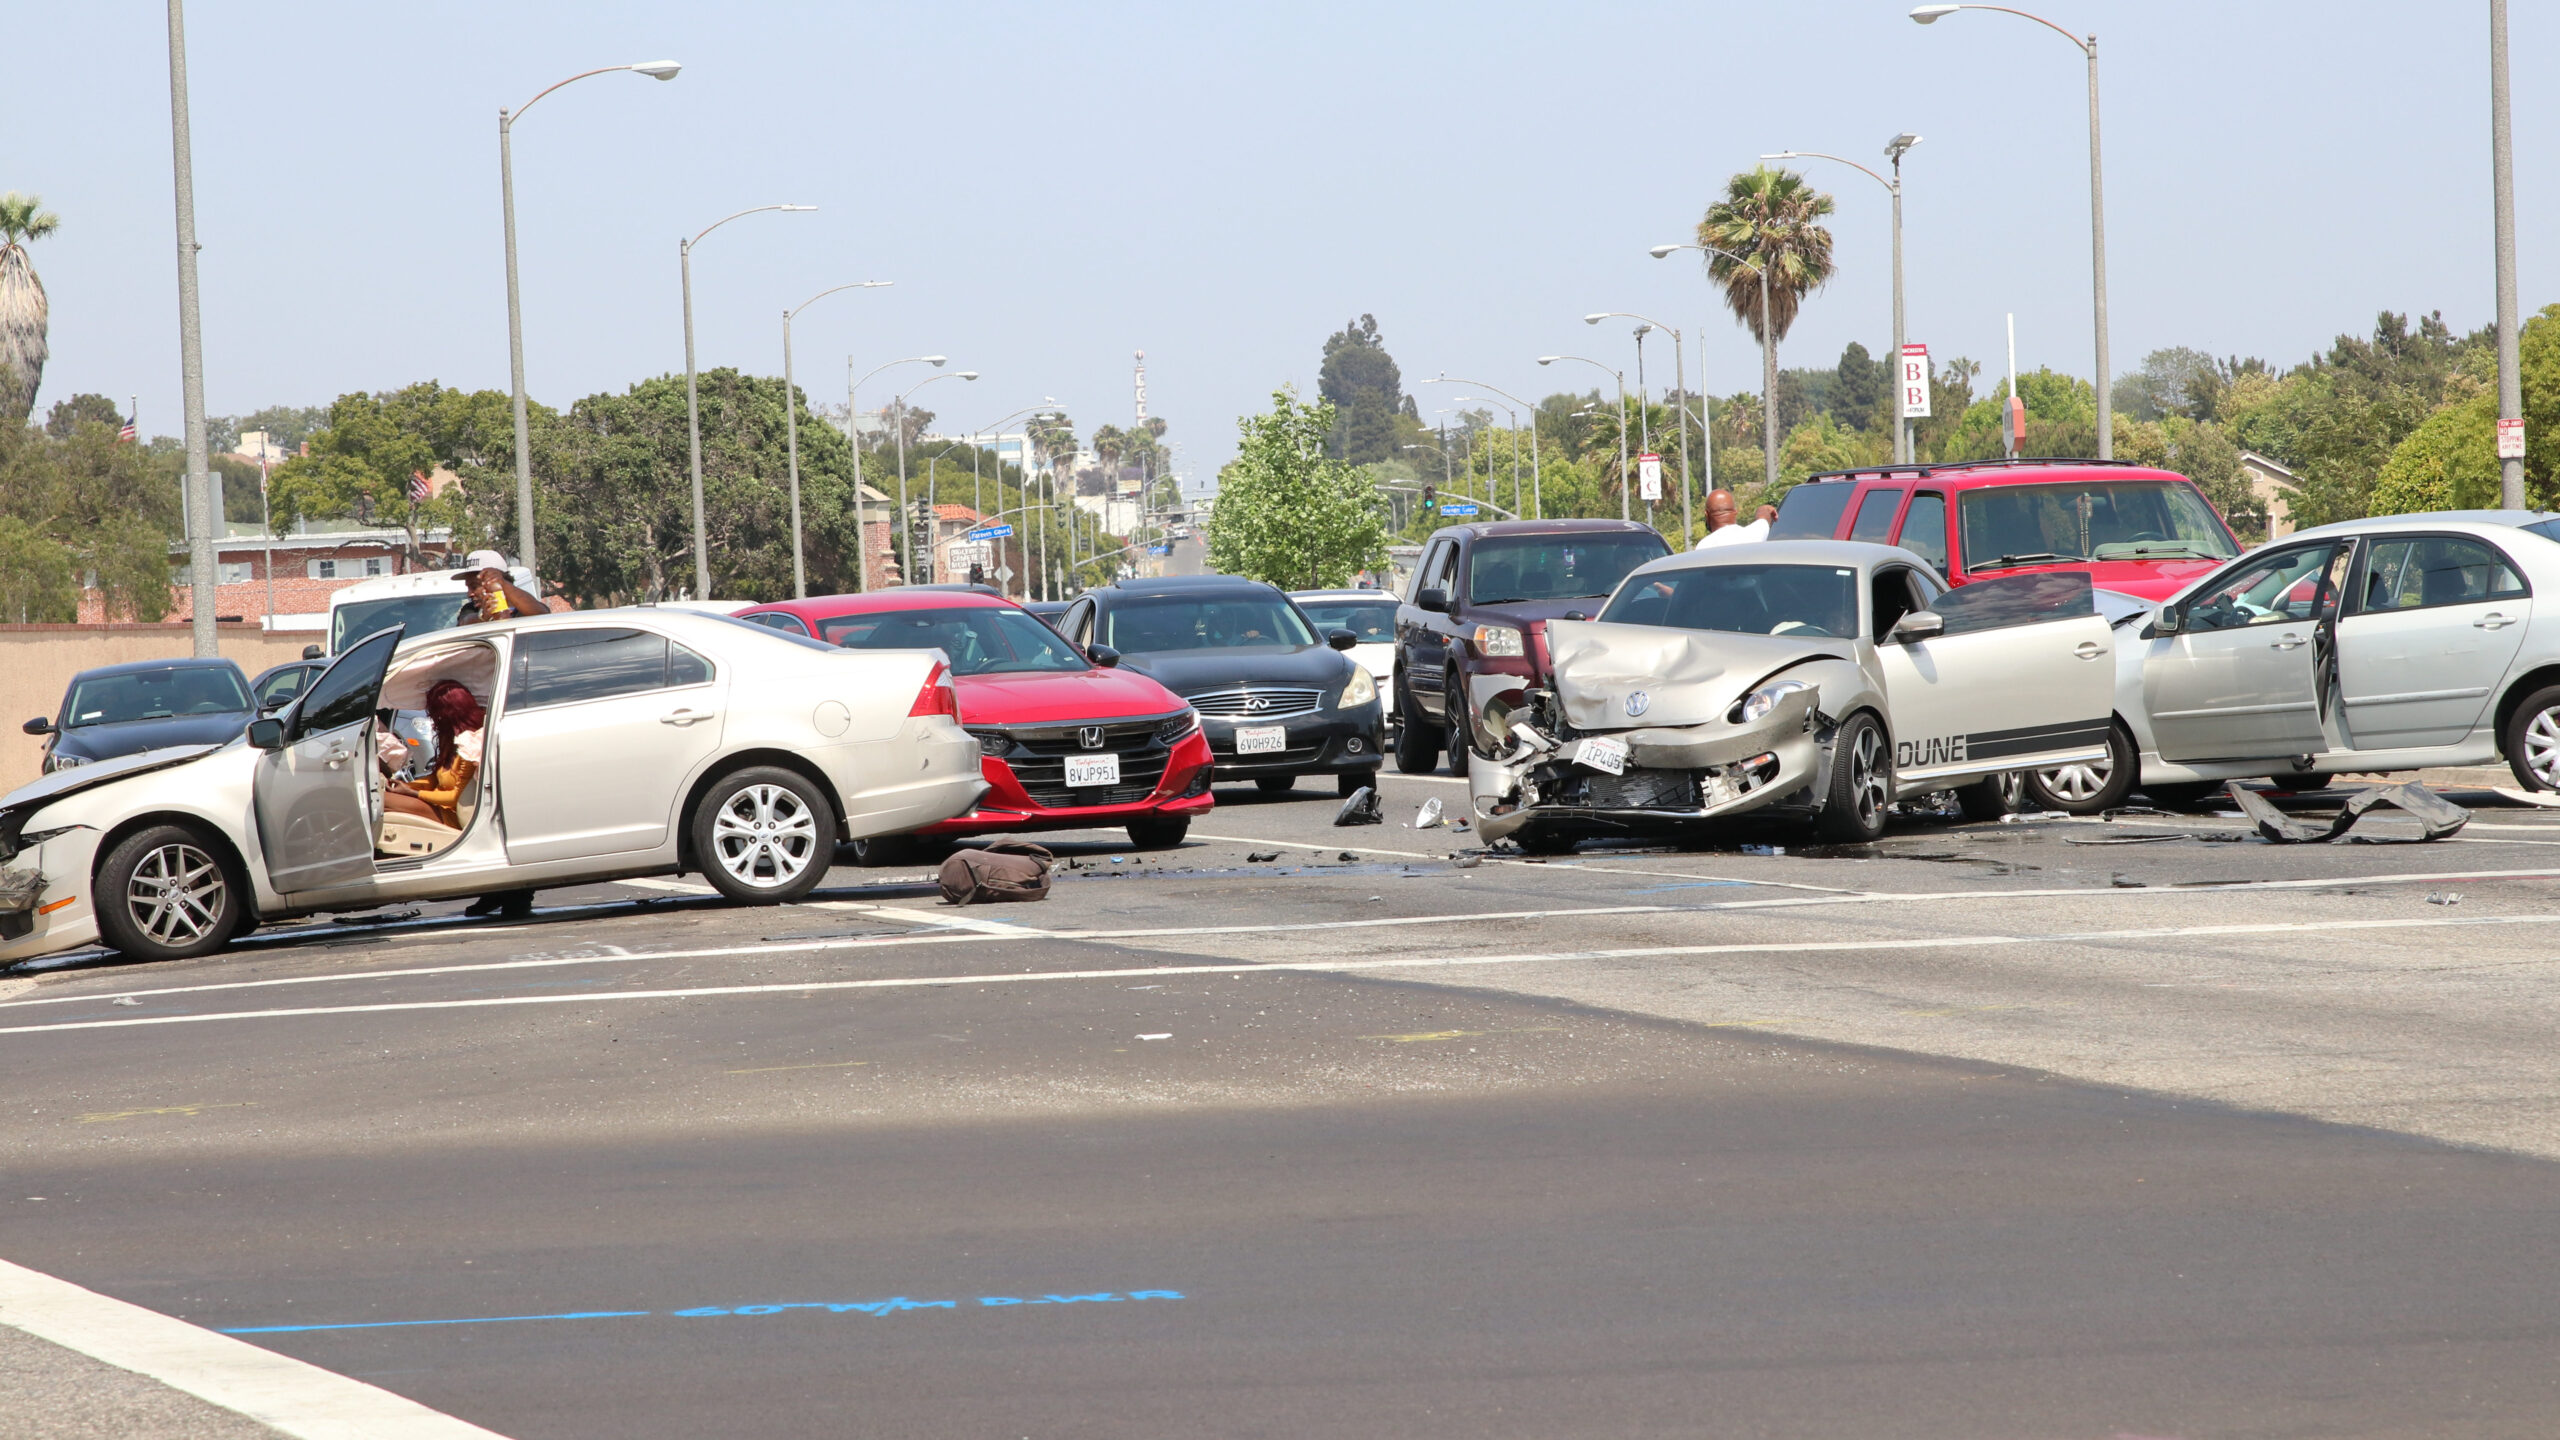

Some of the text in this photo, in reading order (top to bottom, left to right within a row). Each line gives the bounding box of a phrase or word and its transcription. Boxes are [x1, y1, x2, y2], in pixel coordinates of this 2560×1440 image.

[1905, 363, 1921, 381] B
[1906, 387, 1923, 405] B
[1646, 465, 1656, 478] C
[1647, 480, 1656, 492] C
[1897, 734, 1965, 769] DUNE
[1069, 766, 1116, 782] 8VJP951
